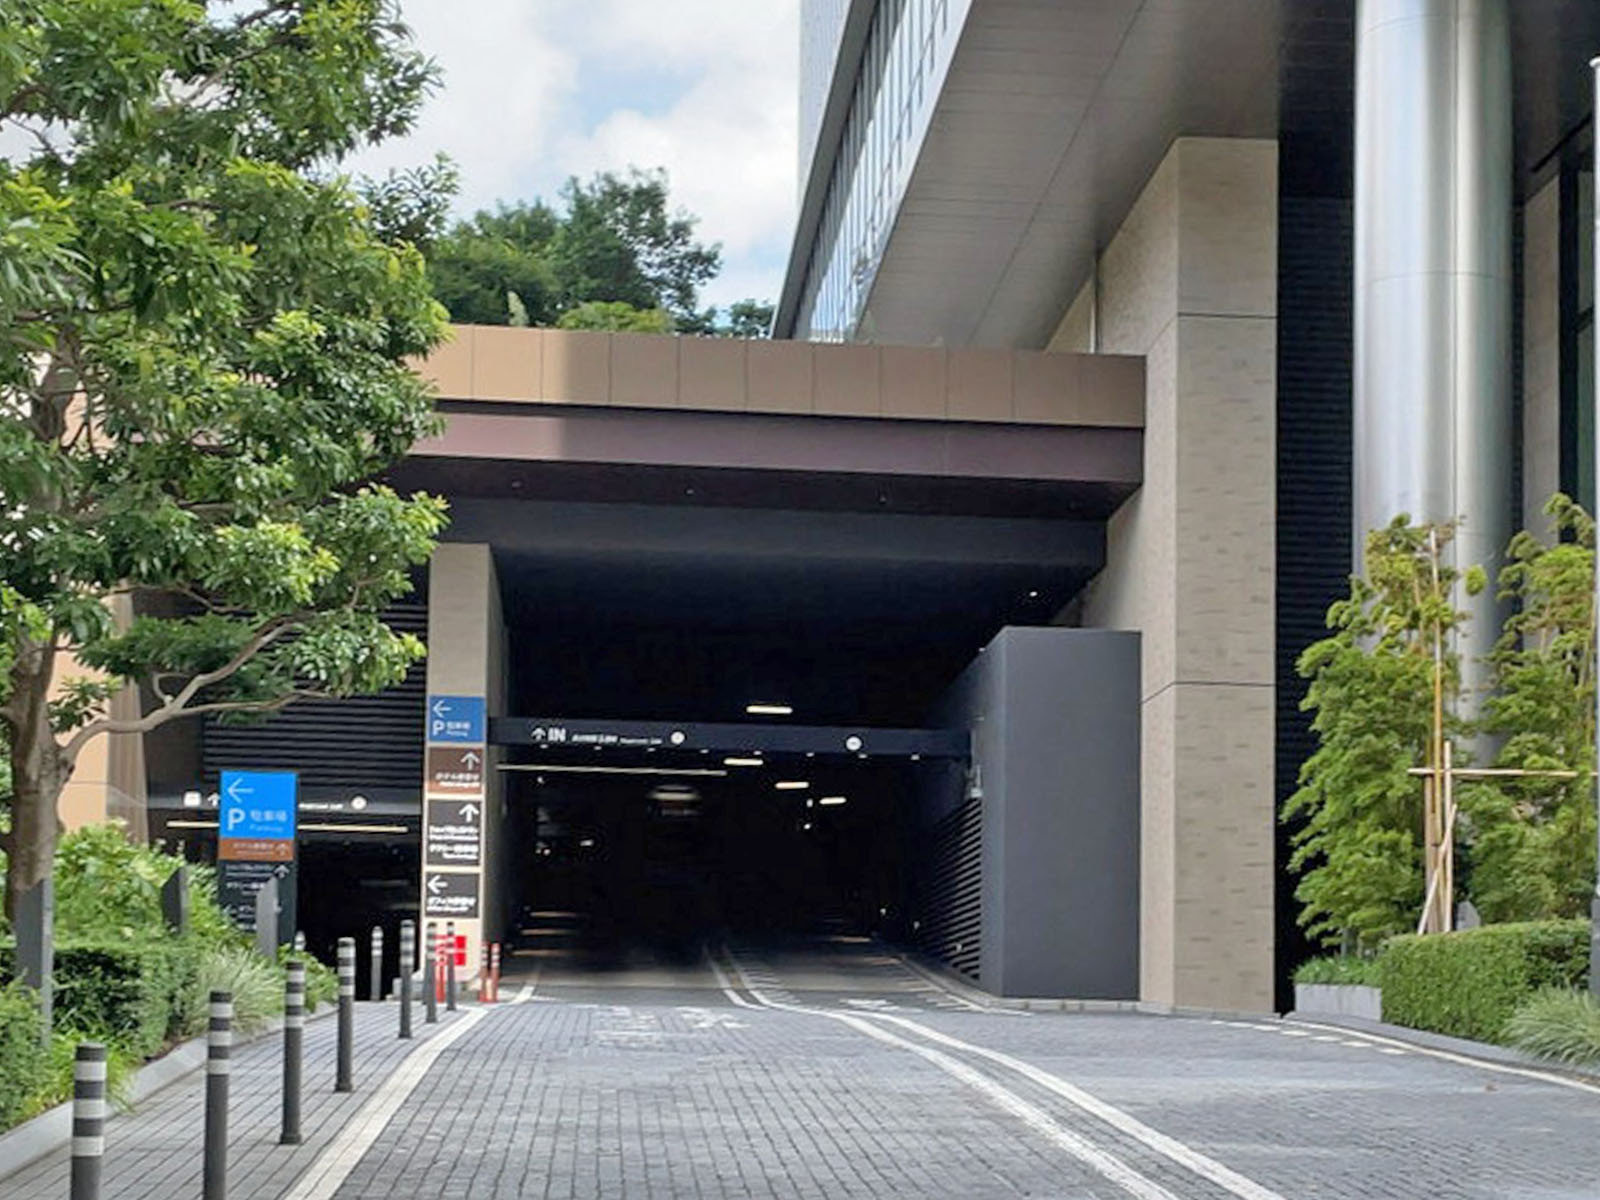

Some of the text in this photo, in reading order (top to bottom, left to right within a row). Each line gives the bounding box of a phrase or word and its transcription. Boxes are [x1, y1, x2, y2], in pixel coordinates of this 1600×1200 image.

[433, 720, 445, 736] P
[548, 727, 566, 742] IN
[227, 808, 246, 831] P
